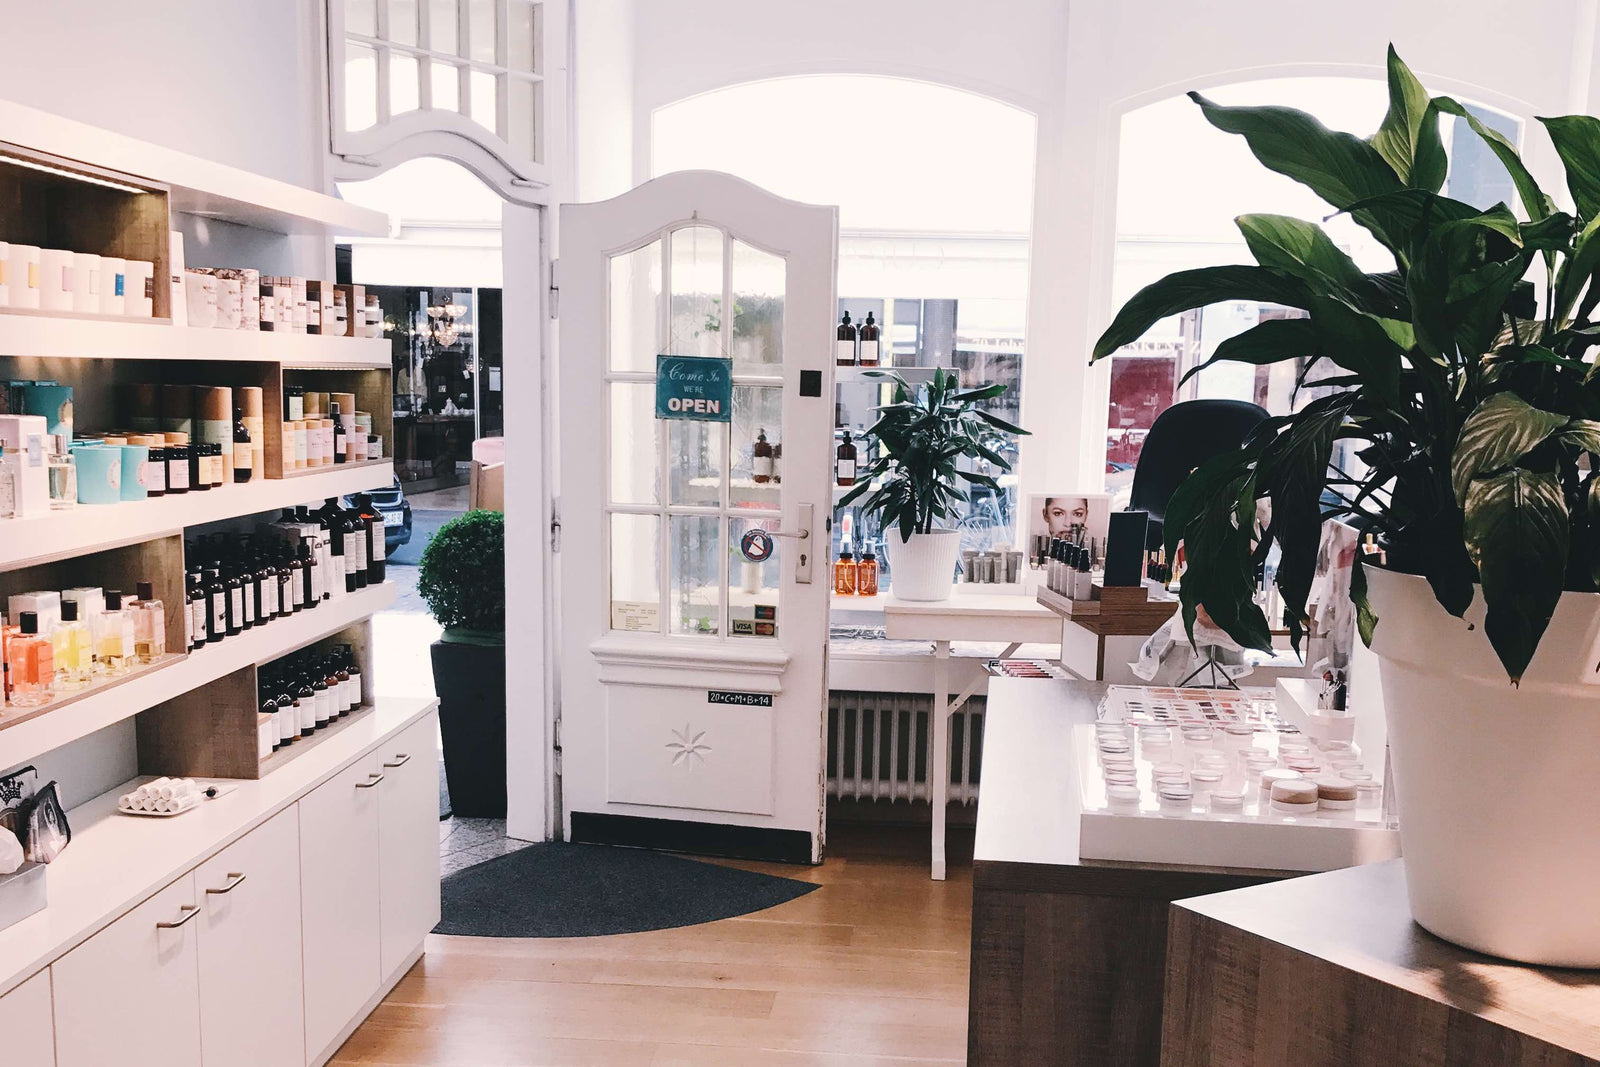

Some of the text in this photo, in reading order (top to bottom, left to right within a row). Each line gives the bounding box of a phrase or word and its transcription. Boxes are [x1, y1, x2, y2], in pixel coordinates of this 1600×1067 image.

[668, 362, 720, 382] Come In
[667, 397, 720, 414] OPEN
